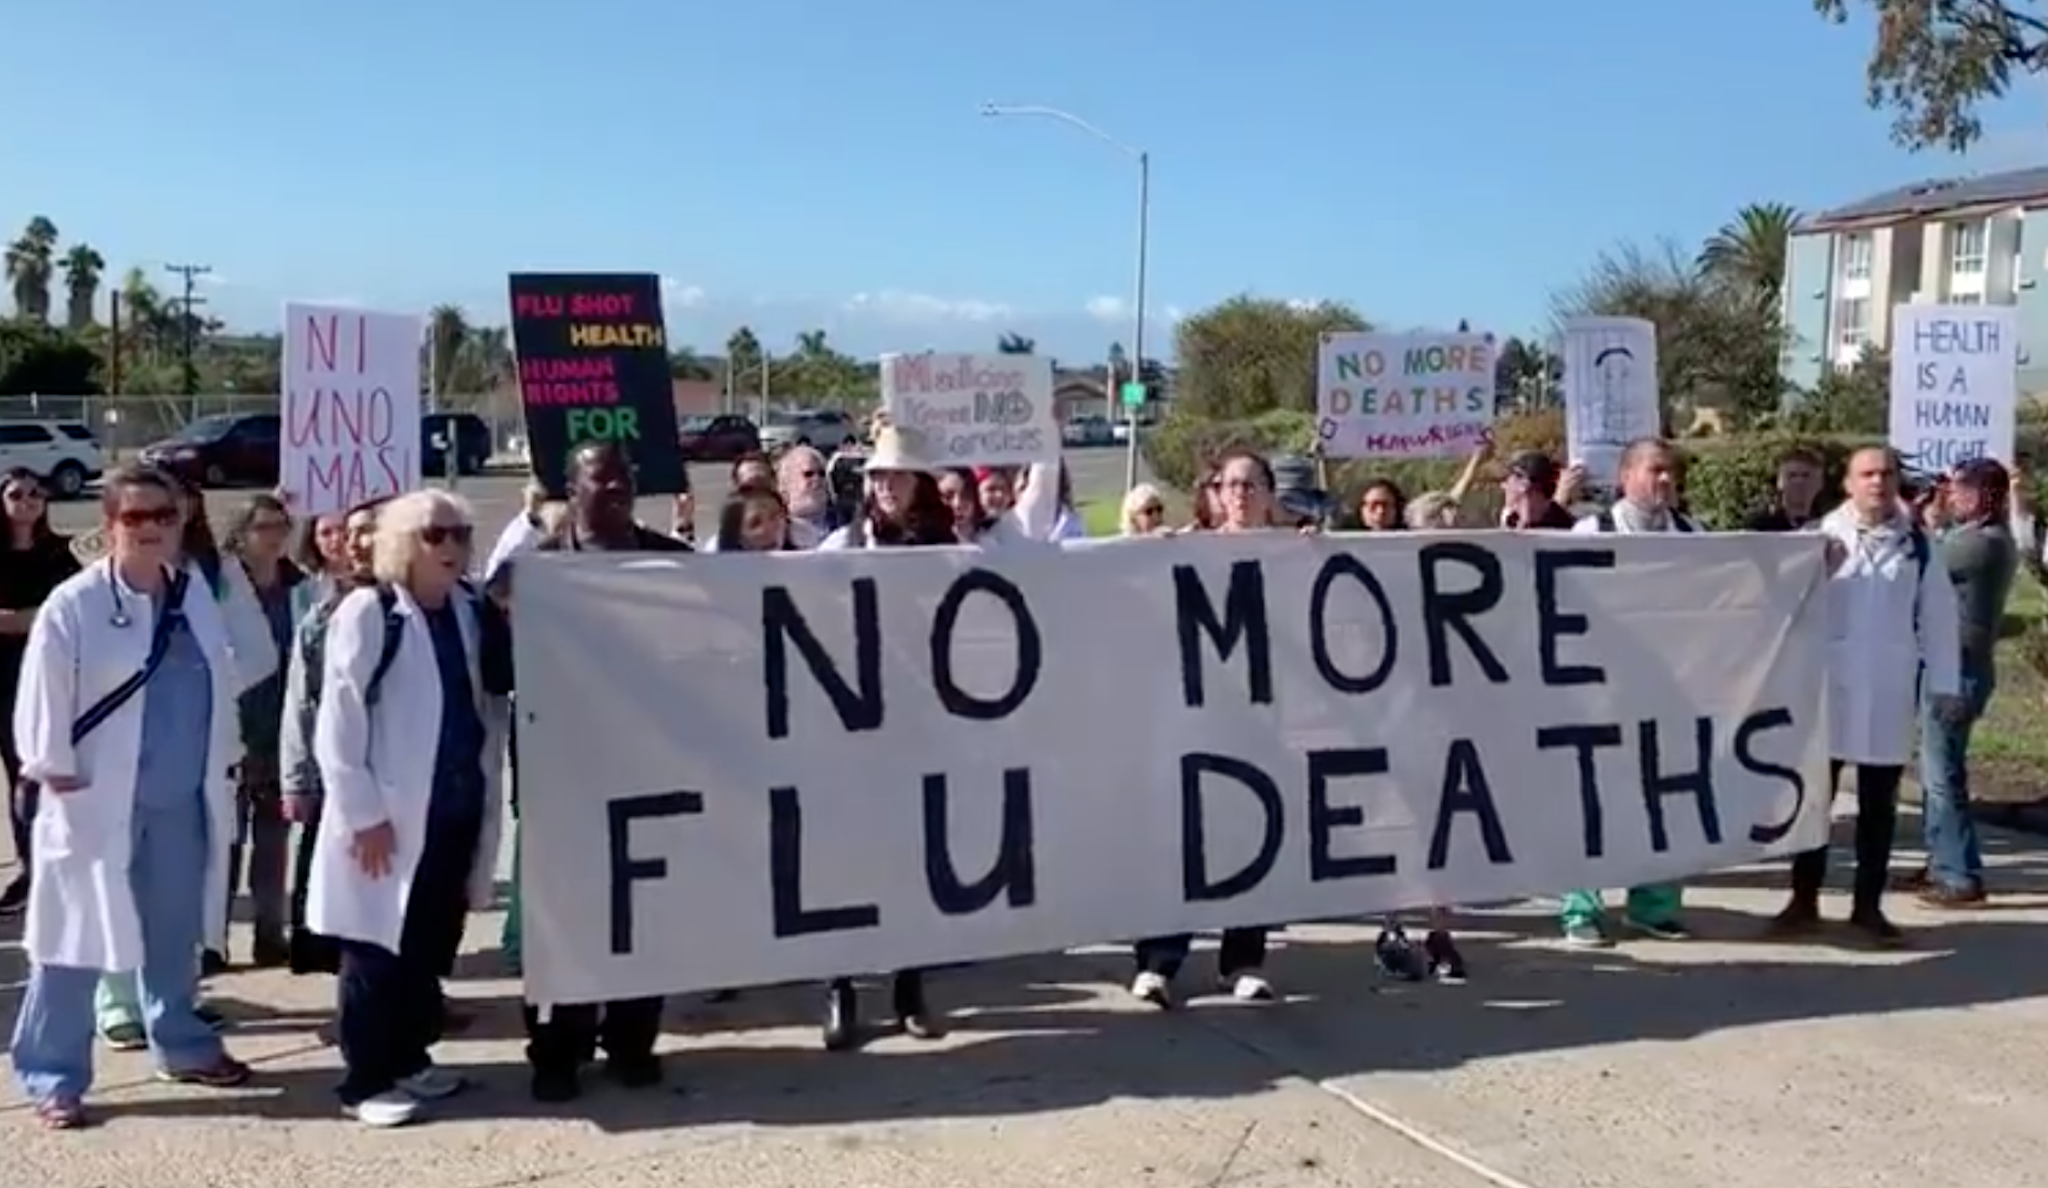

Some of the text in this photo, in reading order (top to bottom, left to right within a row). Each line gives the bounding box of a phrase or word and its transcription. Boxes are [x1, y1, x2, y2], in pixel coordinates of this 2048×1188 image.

[516, 293, 635, 317] FLU SHOT
[307, 314, 366, 374] NI
[569, 322, 664, 347] HEALTH
[1914, 318, 2001, 354] HEALTH
[522, 357, 615, 380] HUMAN
[1337, 345, 1488, 382] NO MORE
[1917, 361, 1968, 395] IS A
[525, 381, 620, 405] RIGHTS
[974, 391, 1035, 427] NO
[1329, 385, 1485, 416] DEATHS
[289, 386, 393, 448] UNO
[565, 406, 641, 442] FOR
[1915, 401, 1990, 429] HUMAN
[1917, 438, 1987, 469] RIGHT
[762, 541, 1616, 739] NO MORE
[606, 707, 1804, 954] FLU DEATHS
